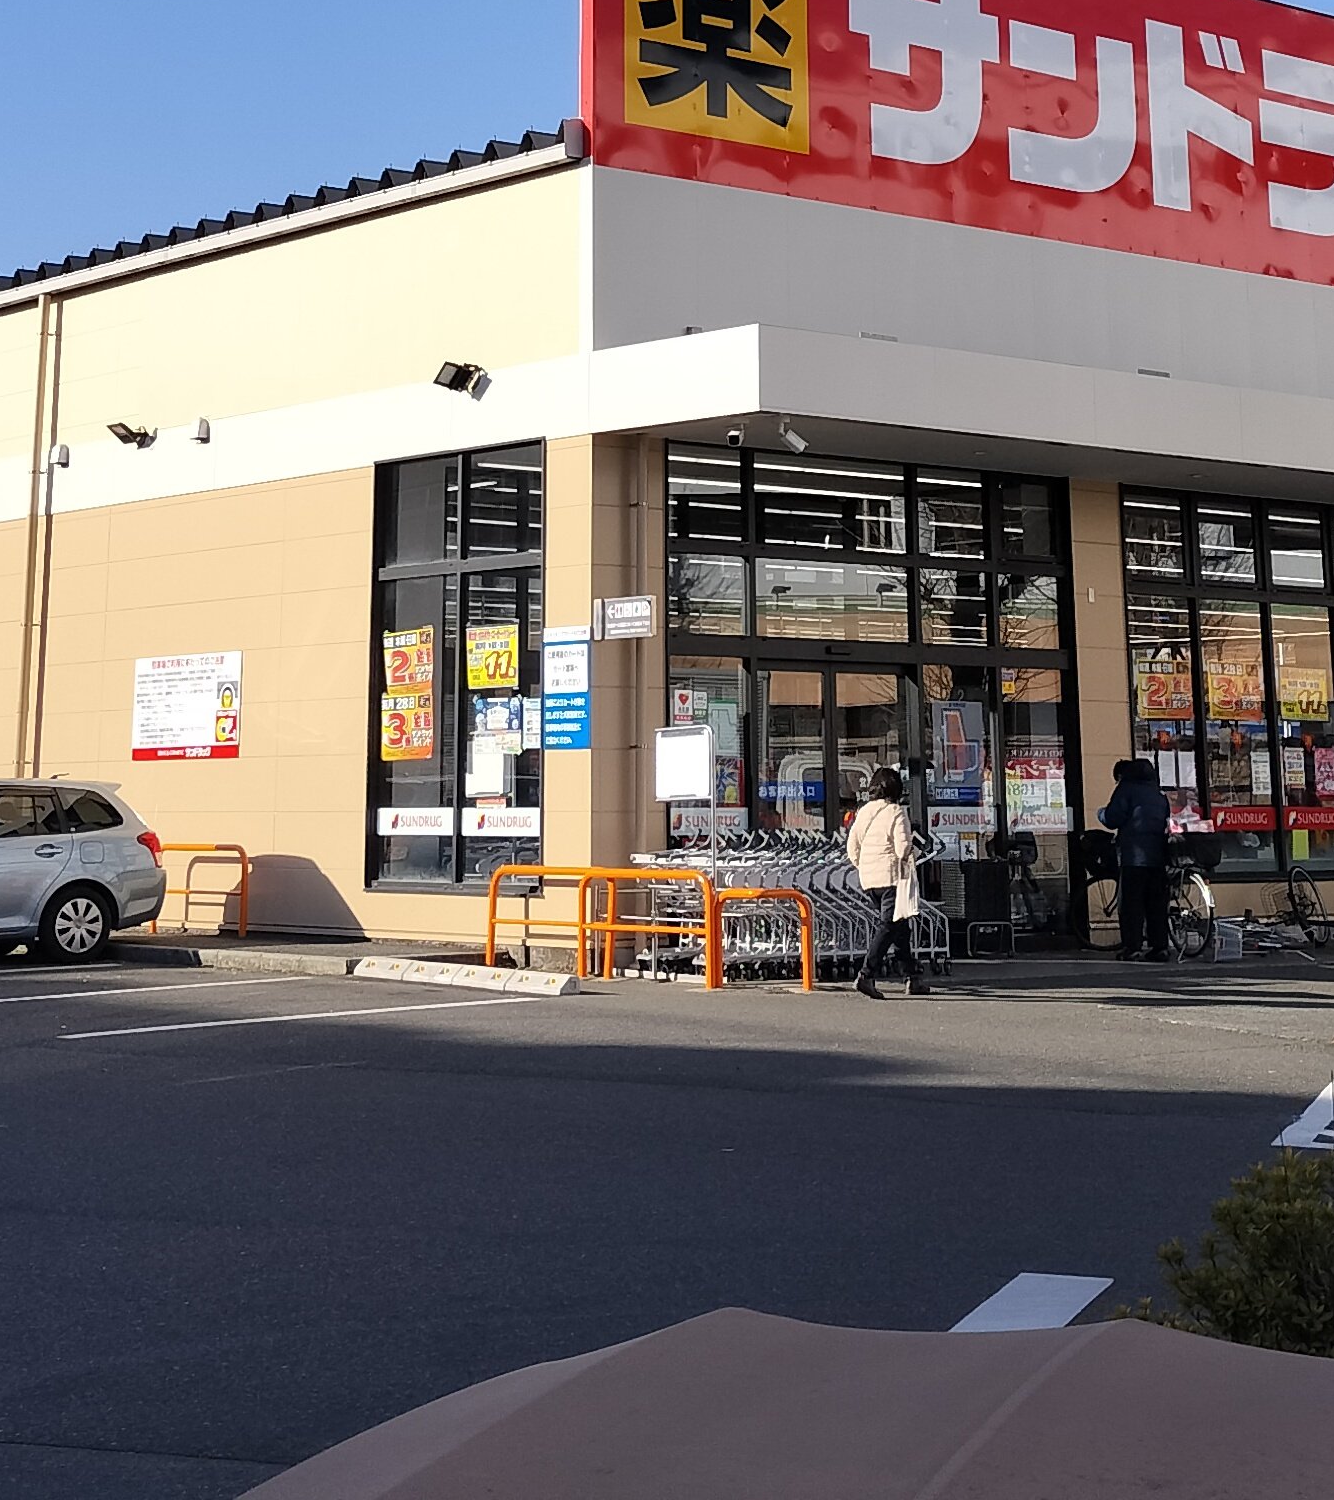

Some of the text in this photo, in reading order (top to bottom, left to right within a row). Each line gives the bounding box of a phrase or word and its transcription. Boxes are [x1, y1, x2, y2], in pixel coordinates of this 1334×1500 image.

[400, 815, 443, 827] SUNDRUG
[487, 815, 532, 828] SUNDRUG
[1225, 812, 1268, 825] SUNDRUG
